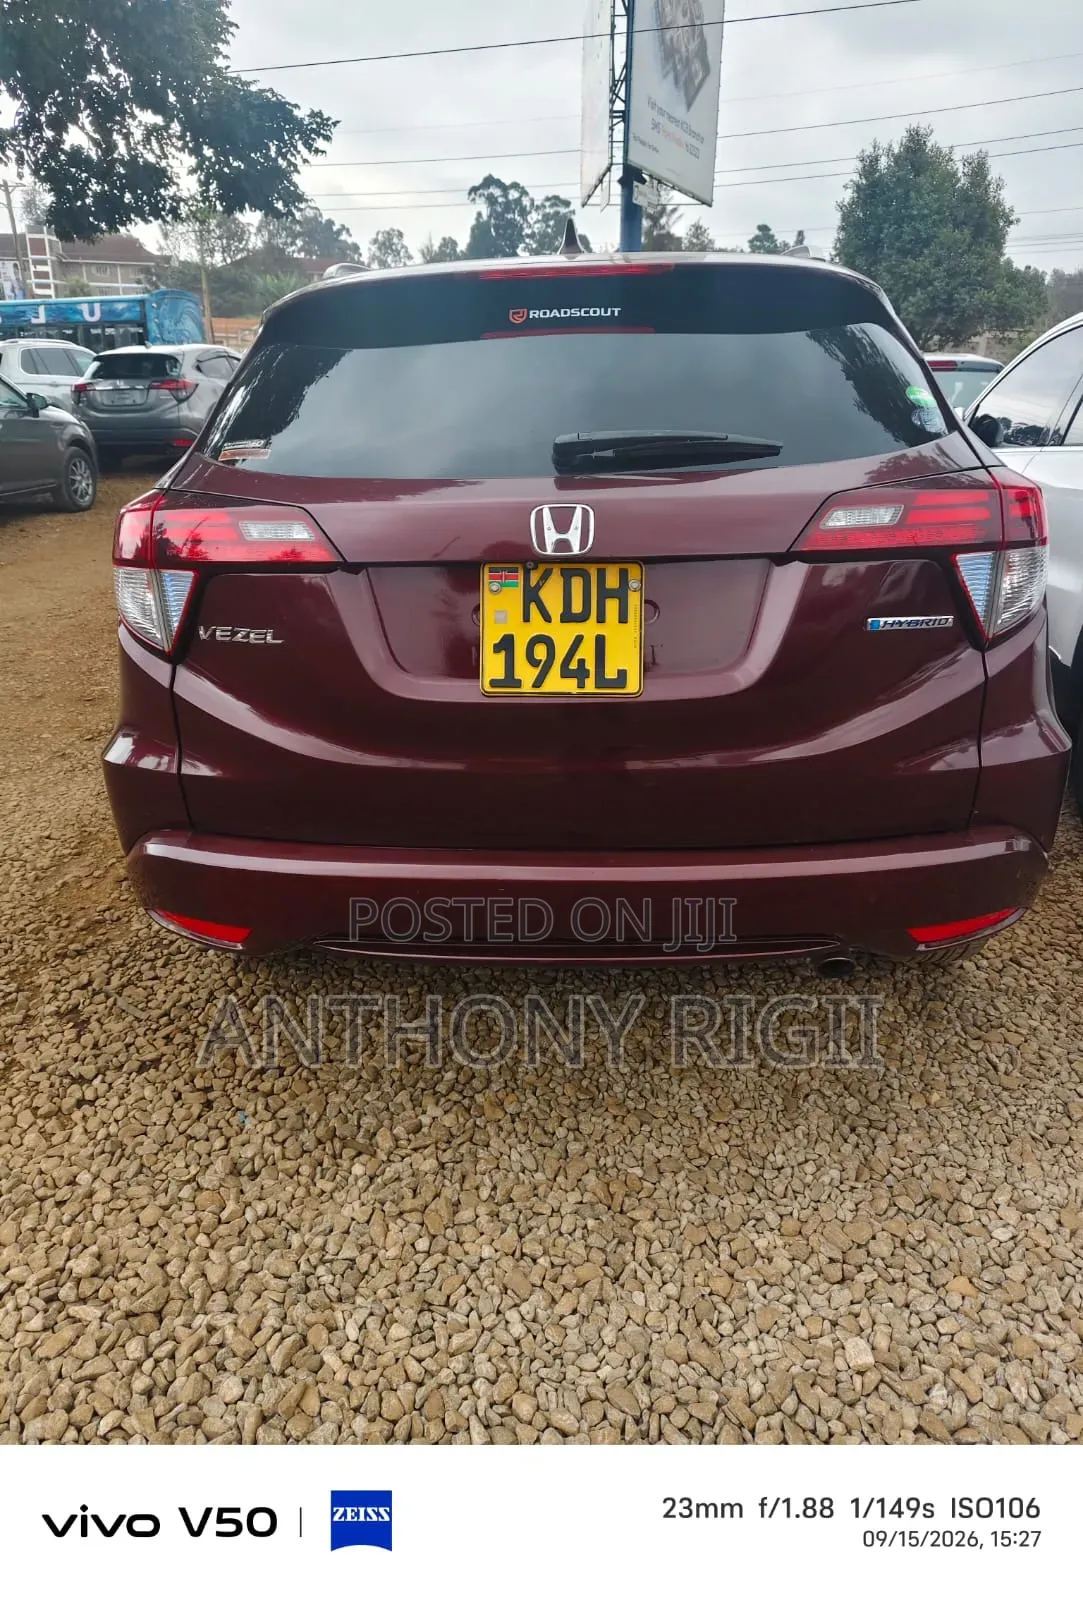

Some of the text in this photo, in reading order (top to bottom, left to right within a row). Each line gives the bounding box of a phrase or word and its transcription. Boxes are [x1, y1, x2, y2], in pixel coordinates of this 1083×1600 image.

[529, 307, 622, 319] ROADSCOUT
[523, 567, 629, 623] KDH
[881, 617, 949, 628] HYBRID
[198, 625, 285, 644] VEZEL
[489, 633, 628, 689] 194L
